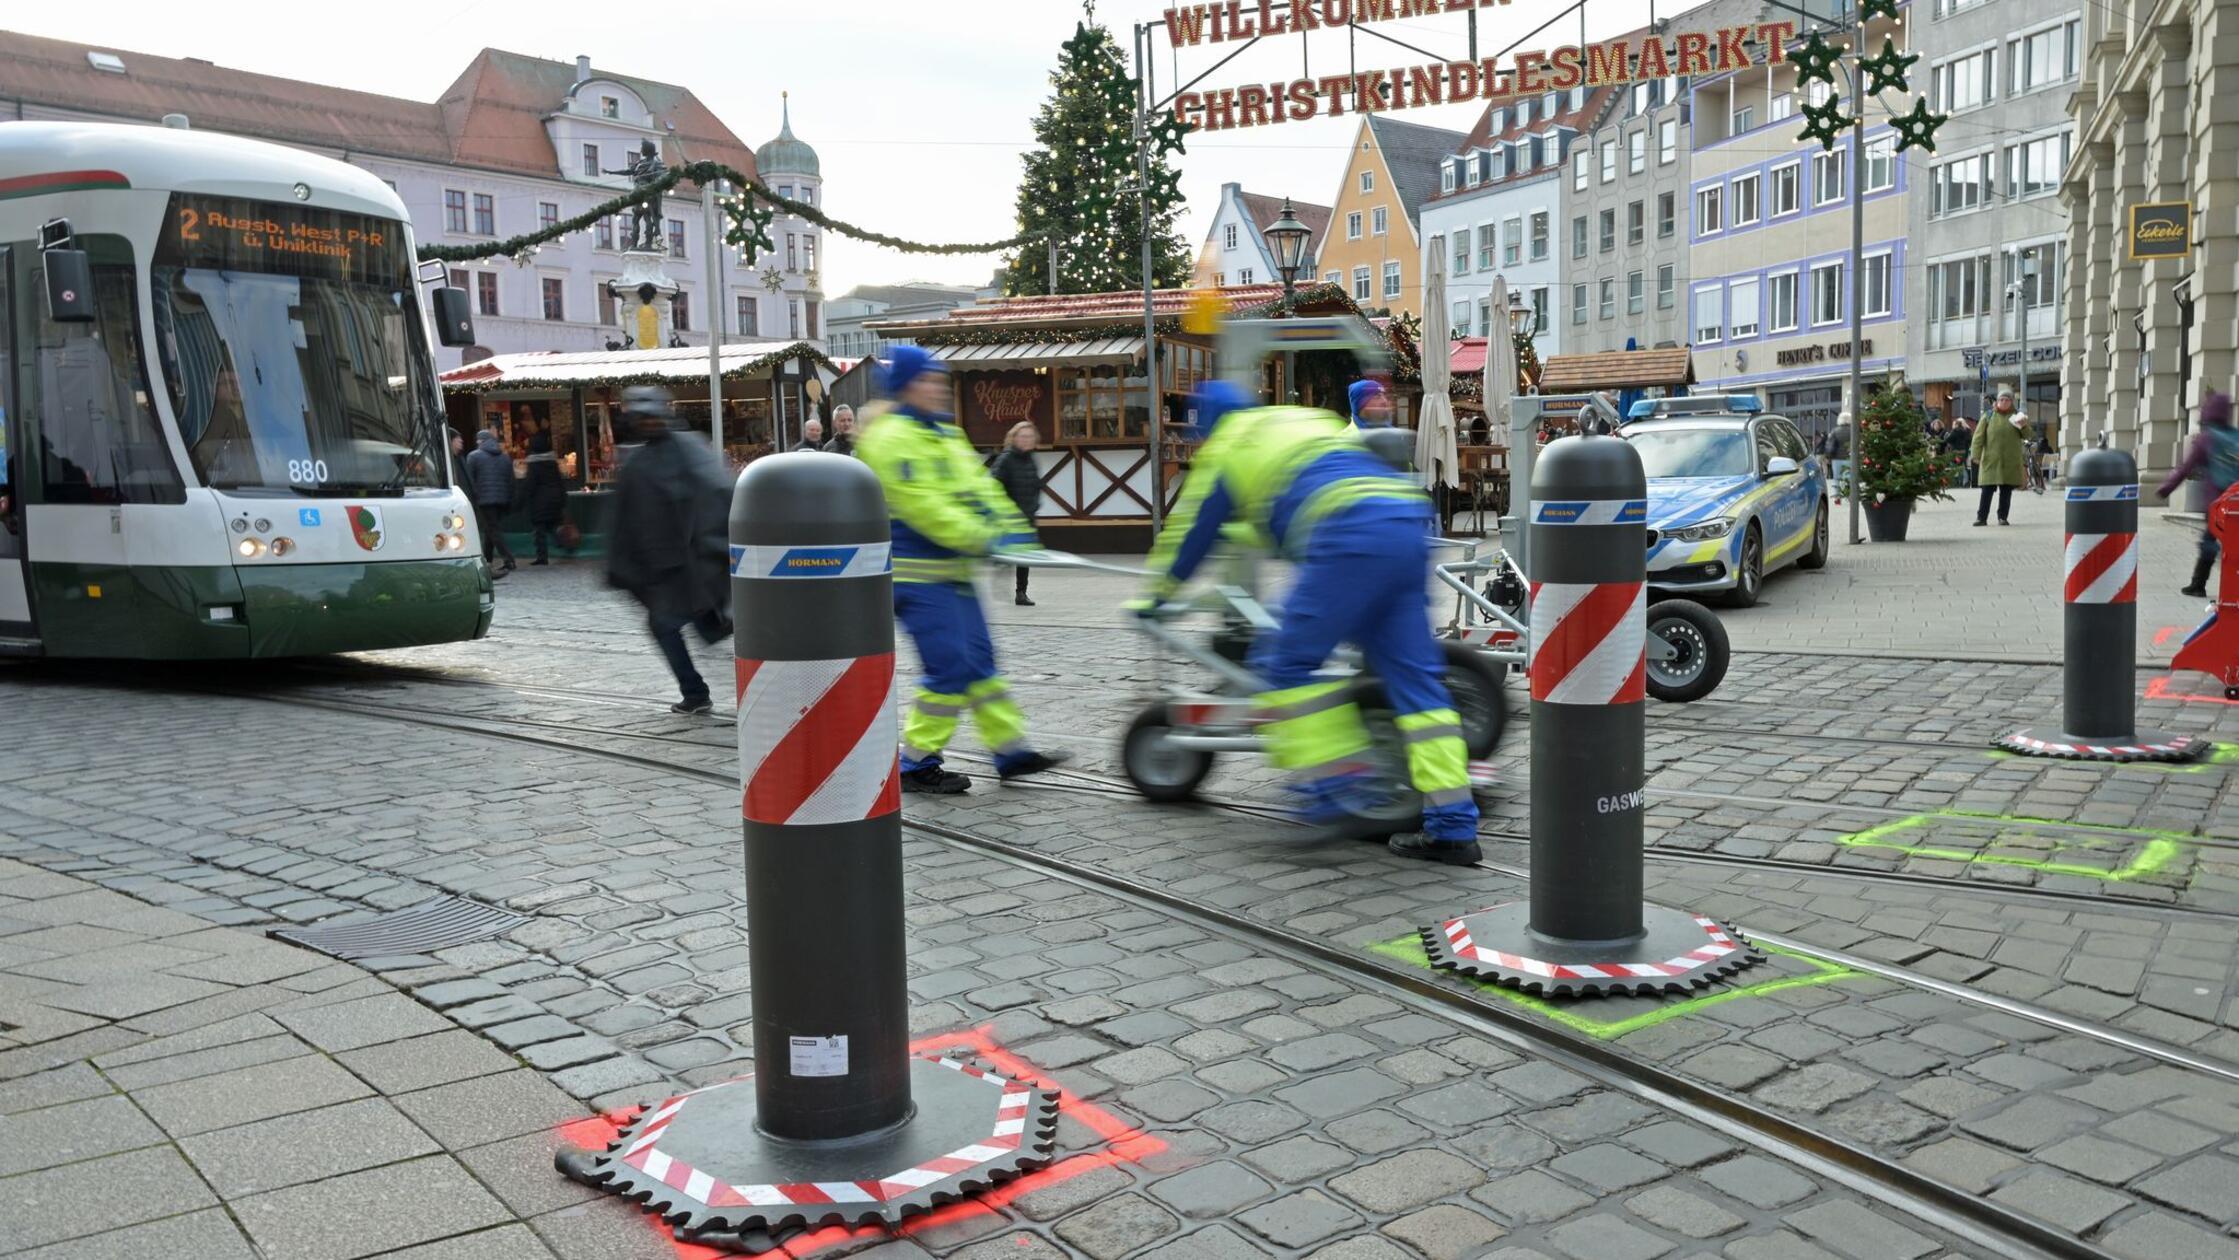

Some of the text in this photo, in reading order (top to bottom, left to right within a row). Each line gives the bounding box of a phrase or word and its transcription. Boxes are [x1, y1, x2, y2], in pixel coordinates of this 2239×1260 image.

[1174, 19, 1796, 133] CHRISTKINDLESMARKT
[179, 208, 199, 240] 2
[291, 222, 341, 242] West
[347, 229, 384, 247] P+R
[269, 236, 351, 258] Uniklinik
[1776, 344, 1825, 366] HENRY'S
[975, 380, 1043, 404] Knusper
[288, 459, 328, 483] 880
